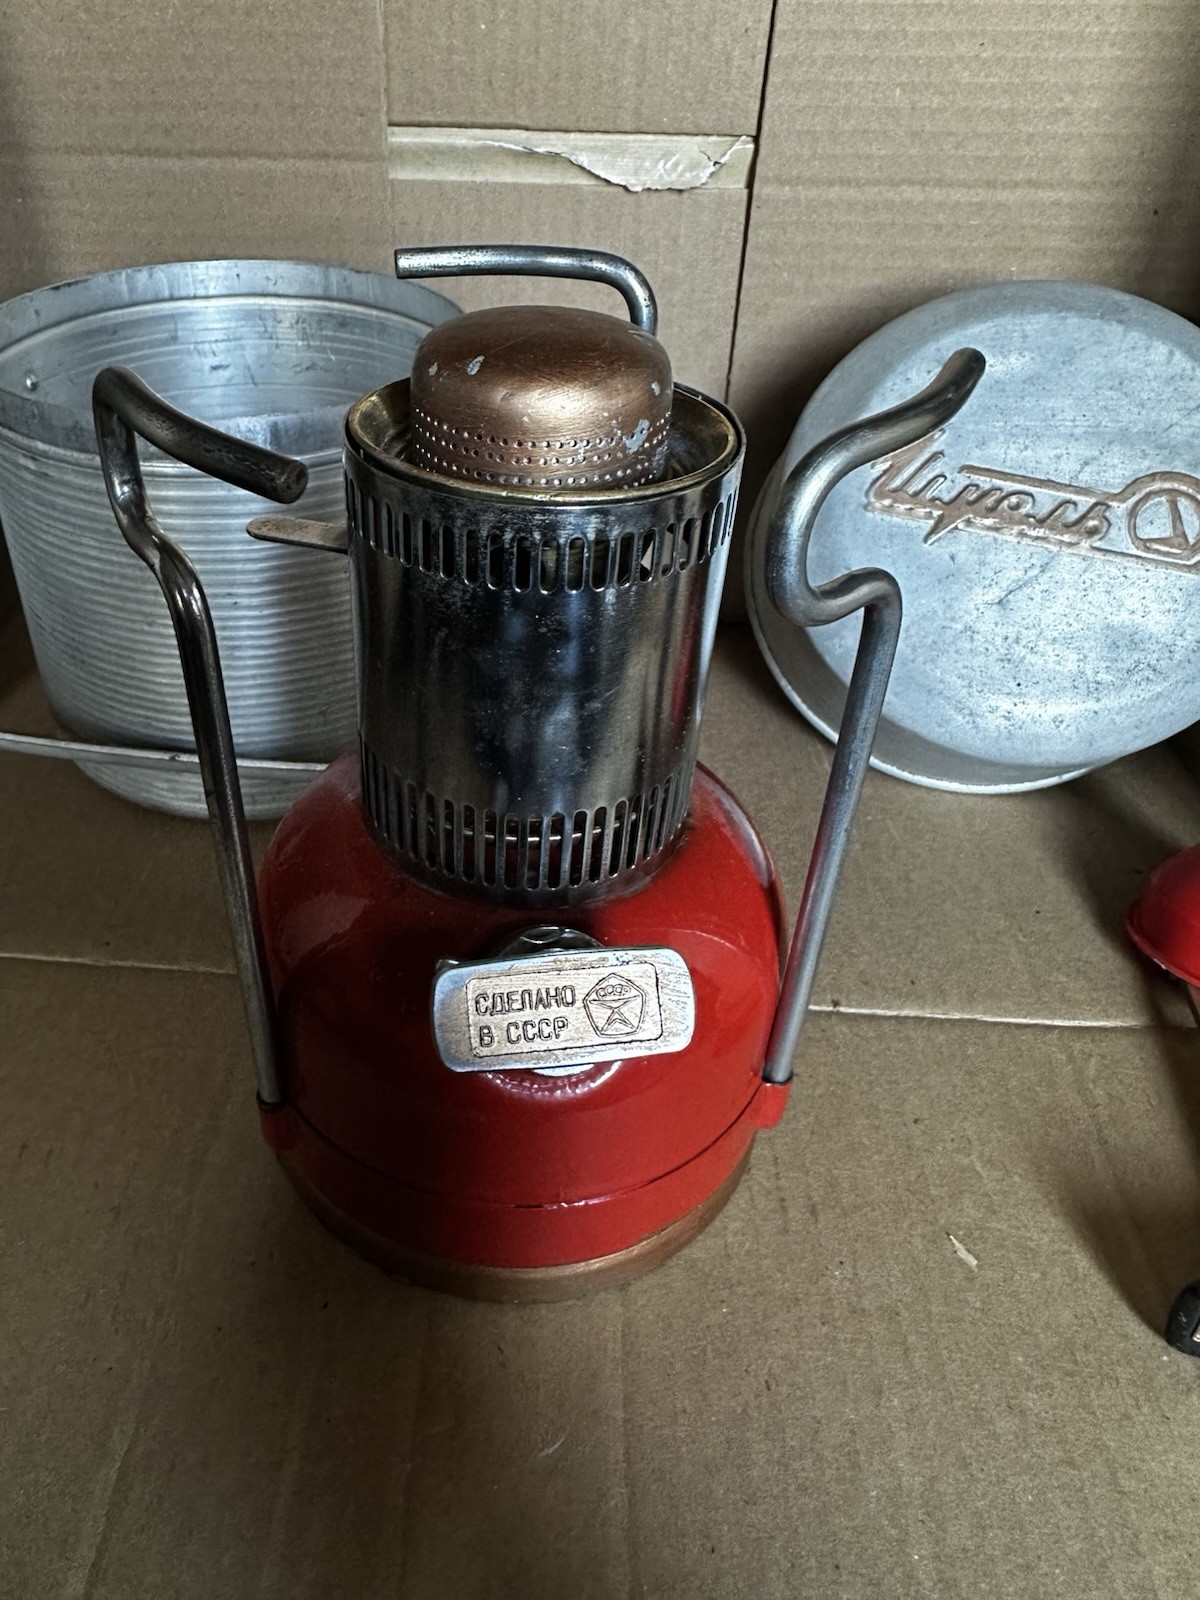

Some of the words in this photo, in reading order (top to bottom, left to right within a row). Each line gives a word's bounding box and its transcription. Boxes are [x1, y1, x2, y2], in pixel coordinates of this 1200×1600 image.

[475, 984, 577, 1016] СДЕЛАНО
[480, 1025, 495, 1048] В
[506, 1016, 569, 1044] СССР
